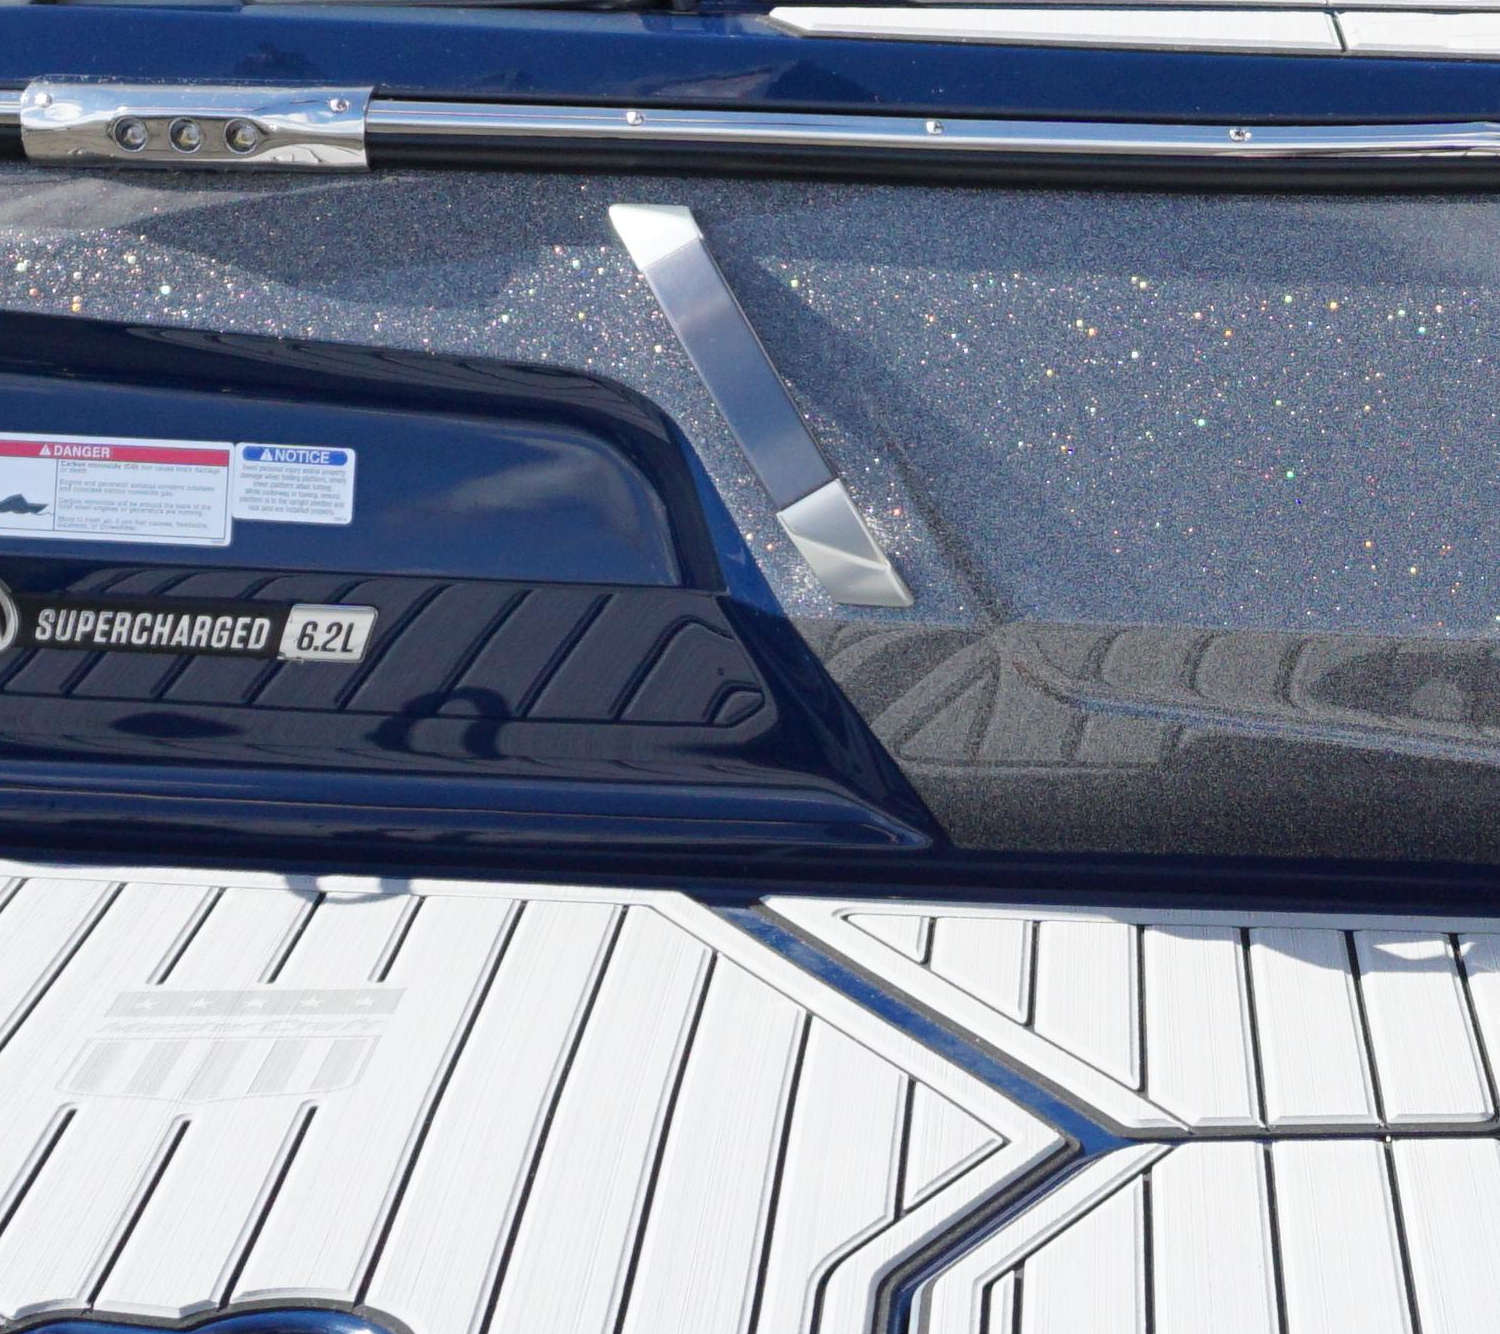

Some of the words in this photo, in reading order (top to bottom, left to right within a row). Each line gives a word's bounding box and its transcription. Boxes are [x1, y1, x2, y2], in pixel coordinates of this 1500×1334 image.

[53, 444, 111, 459] DANGER
[274, 448, 331, 464] NOTICE
[34, 608, 271, 650] SUPERCHARGED
[299, 620, 356, 653] 6.2L
